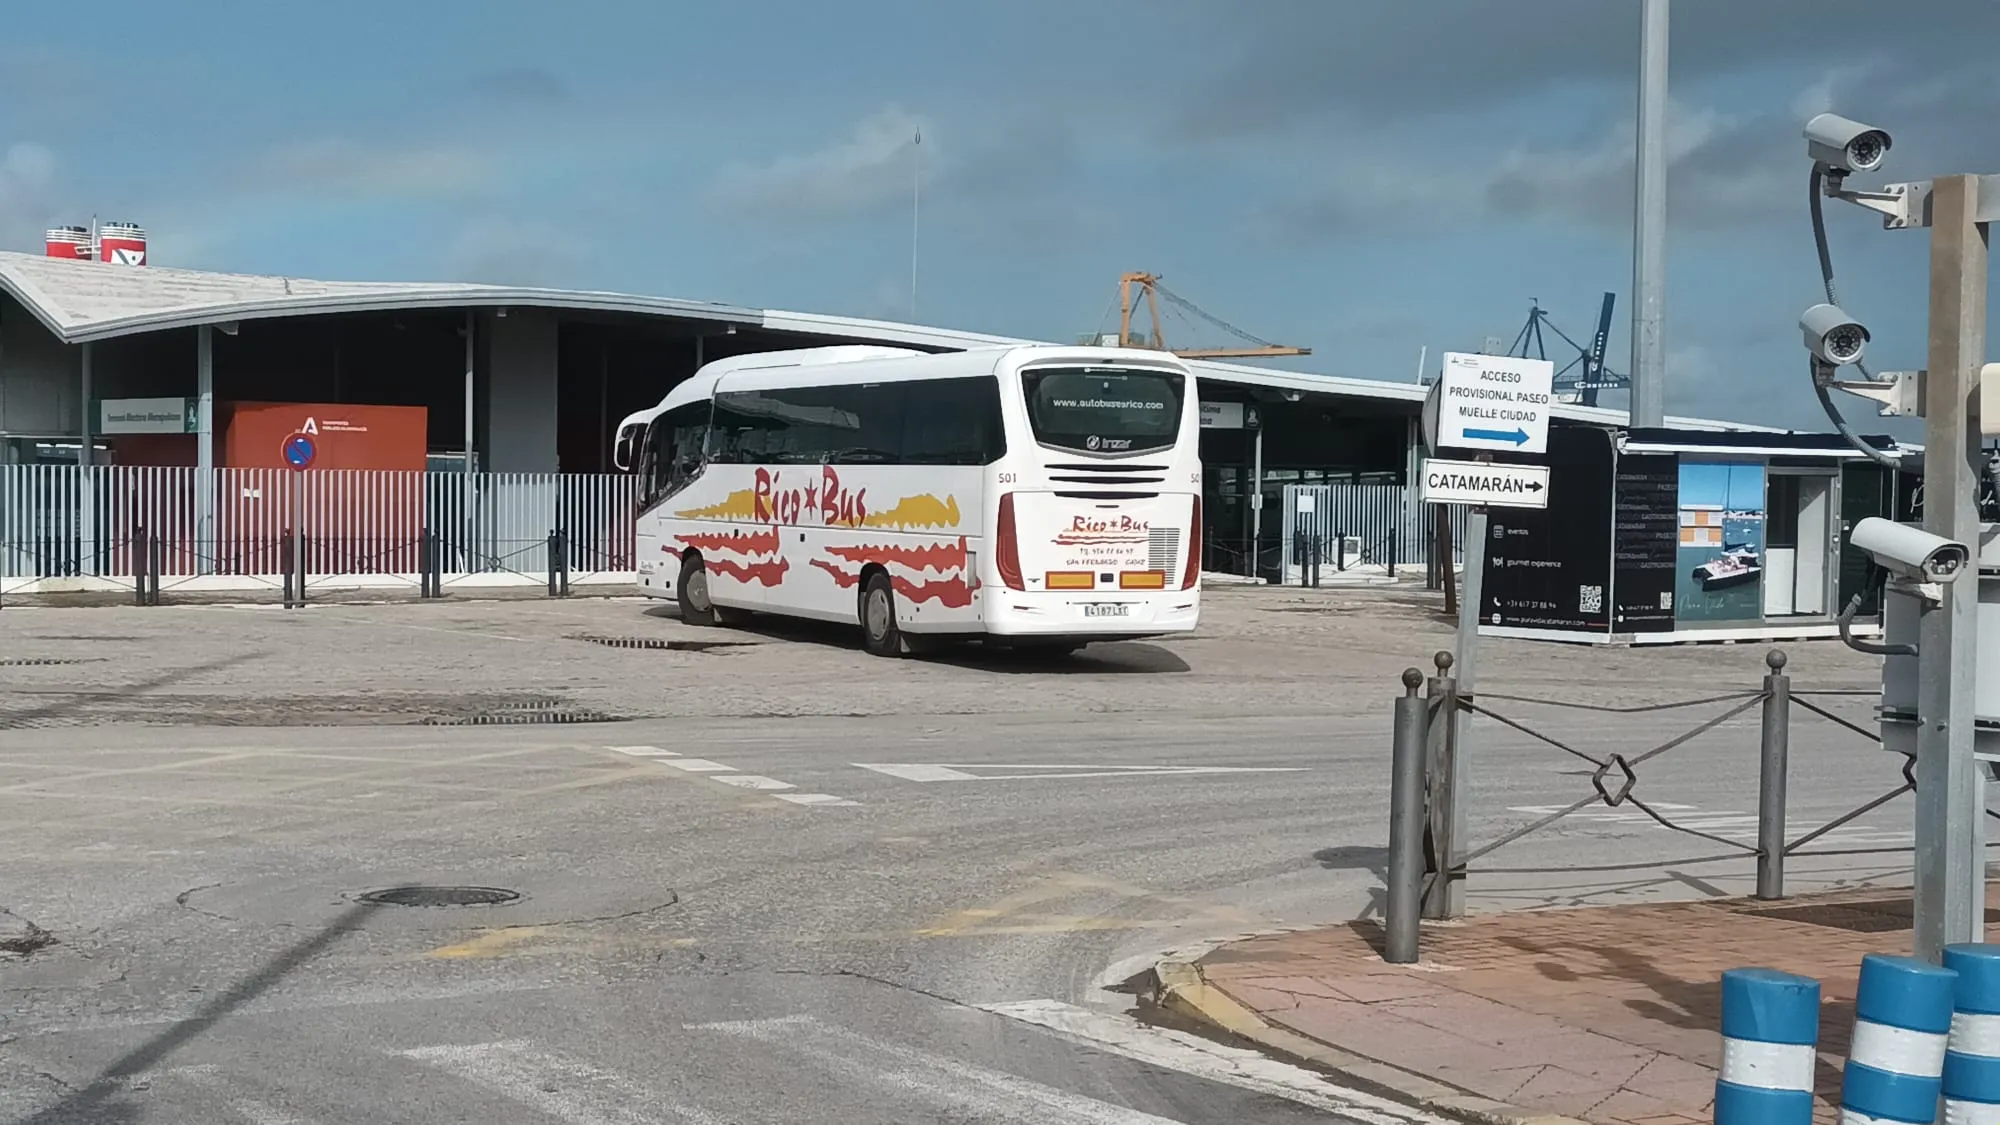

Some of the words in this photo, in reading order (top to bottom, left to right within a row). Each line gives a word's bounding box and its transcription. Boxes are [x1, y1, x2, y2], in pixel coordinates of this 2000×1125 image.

[1480, 370, 1521, 384] ACCESO
[1450, 386, 1514, 402] PROVISIONAL
[1516, 392, 1549, 404] PASEO
[1053, 399, 1164, 409] www.autobusesrico.com
[1459, 406, 1498, 419] MUELLE
[1499, 409, 1537, 422] CIUDAD
[998, 473, 1017, 483] 501
[1428, 473, 1524, 493] CATAMARÁN
[754, 466, 801, 526] Rico
[821, 465, 866, 528] Bus
[1072, 515, 1107, 532] Rico
[1120, 515, 1150, 532] Bus
